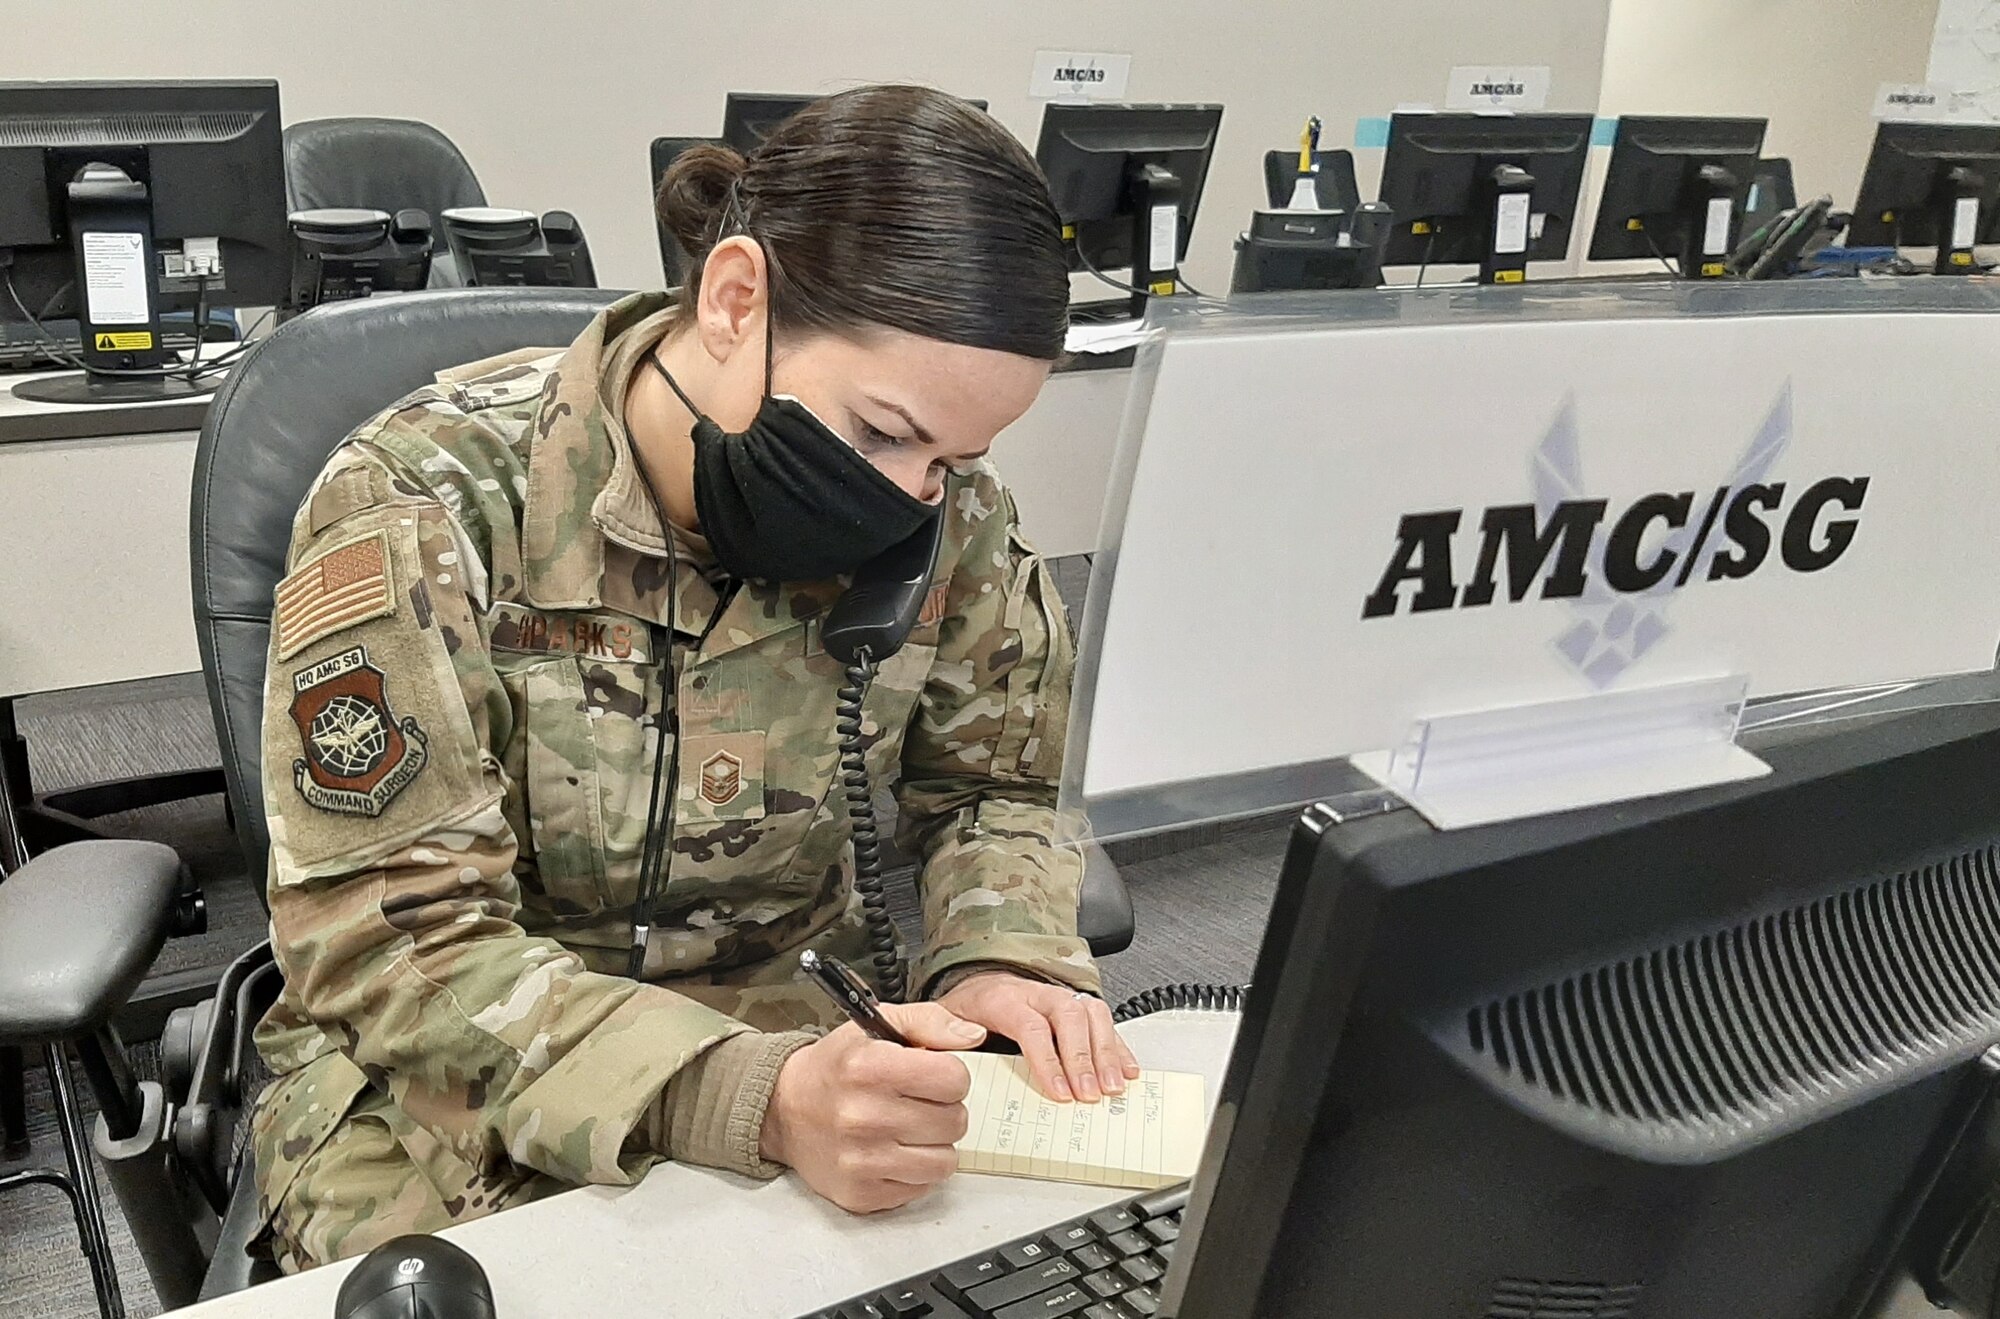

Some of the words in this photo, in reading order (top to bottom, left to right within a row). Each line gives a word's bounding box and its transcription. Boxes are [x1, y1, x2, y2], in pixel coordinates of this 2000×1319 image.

[1360, 476, 1871, 620] AMC/SG
[298, 671, 314, 688] HQ
[316, 660, 341, 680] AMC
[343, 652, 360, 667] SG
[307, 786, 374, 811] COMMAND
[373, 748, 423, 804] SURGEON
[402, 1258, 420, 1276] hp
